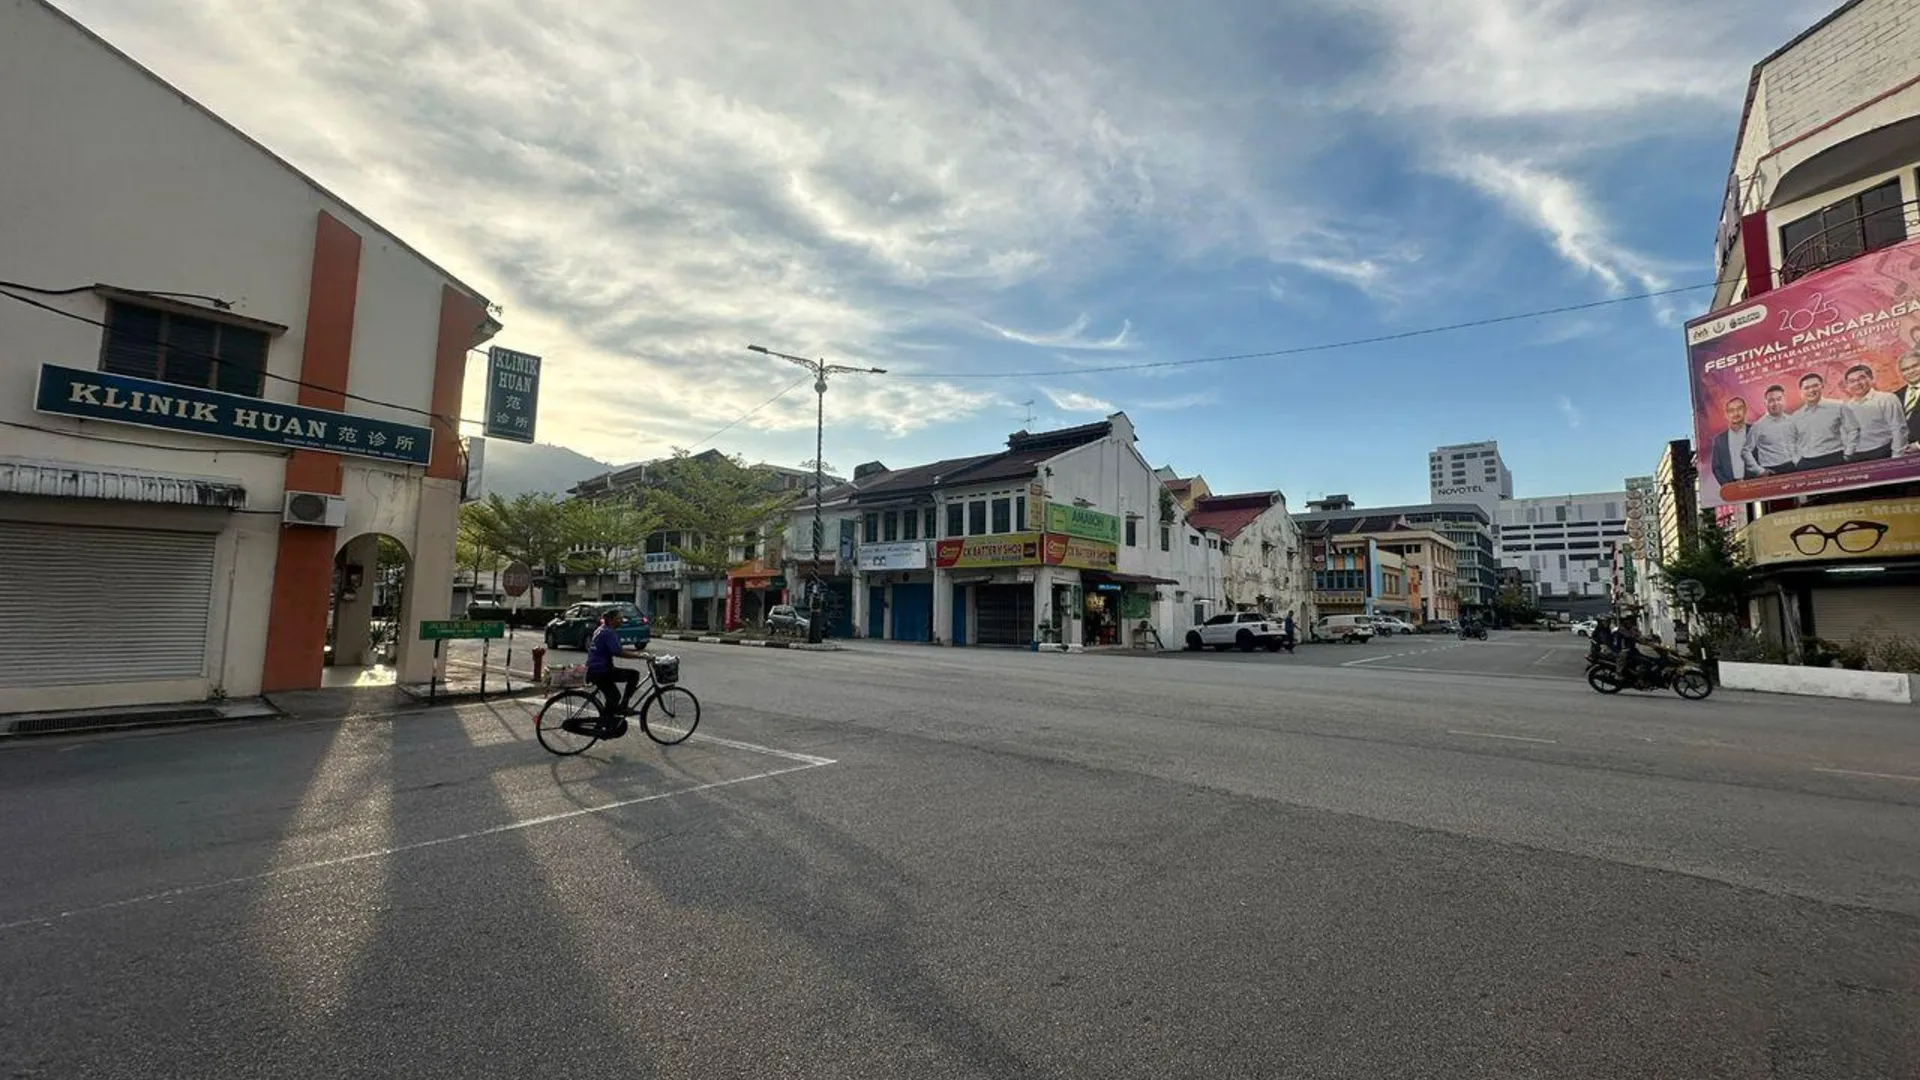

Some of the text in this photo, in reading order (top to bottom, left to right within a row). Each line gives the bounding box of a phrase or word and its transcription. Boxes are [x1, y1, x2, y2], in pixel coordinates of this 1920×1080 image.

[1778, 292, 1838, 332] 2025
[496, 351, 538, 376] KLINIK
[1705, 341, 1788, 373] FESTIVAL
[498, 371, 532, 393] HUAN
[506, 395, 521, 410] 范
[69, 382, 218, 422] KLINIK
[233, 408, 327, 438] HUAN
[338, 426, 415, 451] 范诊所
[1438, 485, 1484, 495] NOVOTEL
[1644, 488, 1654, 514] POH
[973, 544, 1002, 557] BATTERY
